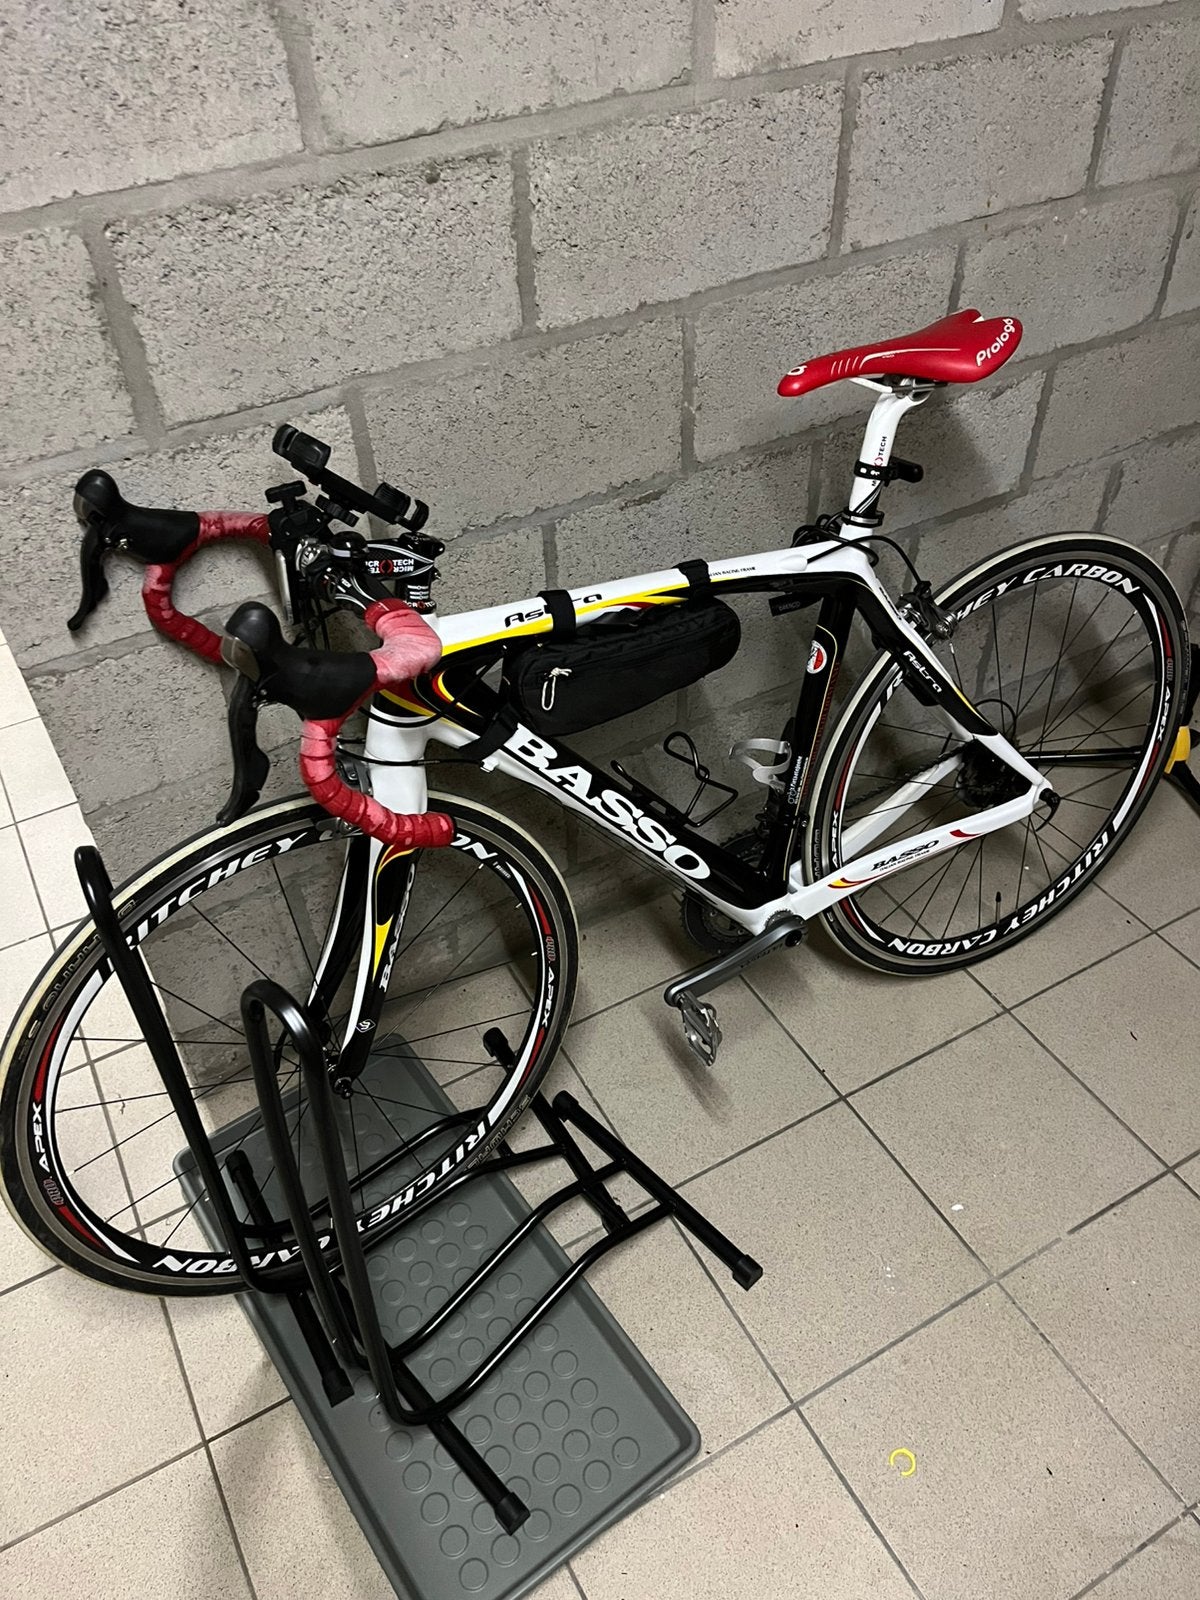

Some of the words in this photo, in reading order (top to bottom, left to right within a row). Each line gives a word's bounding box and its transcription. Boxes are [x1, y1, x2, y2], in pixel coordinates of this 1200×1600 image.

[975, 318, 1015, 366] Prologo
[1022, 563, 1140, 594] CARBON
[903, 650, 942, 692] Astra
[1157, 685, 1171, 742] APEX
[503, 722, 711, 880] BASSO
[831, 810, 839, 869] APEX
[870, 840, 939, 872] BASSO
[1003, 831, 1109, 935] RITCHEY
[887, 929, 997, 956] CARBON
[541, 966, 555, 1028] APEX
[32, 1102, 51, 1173] APEX
